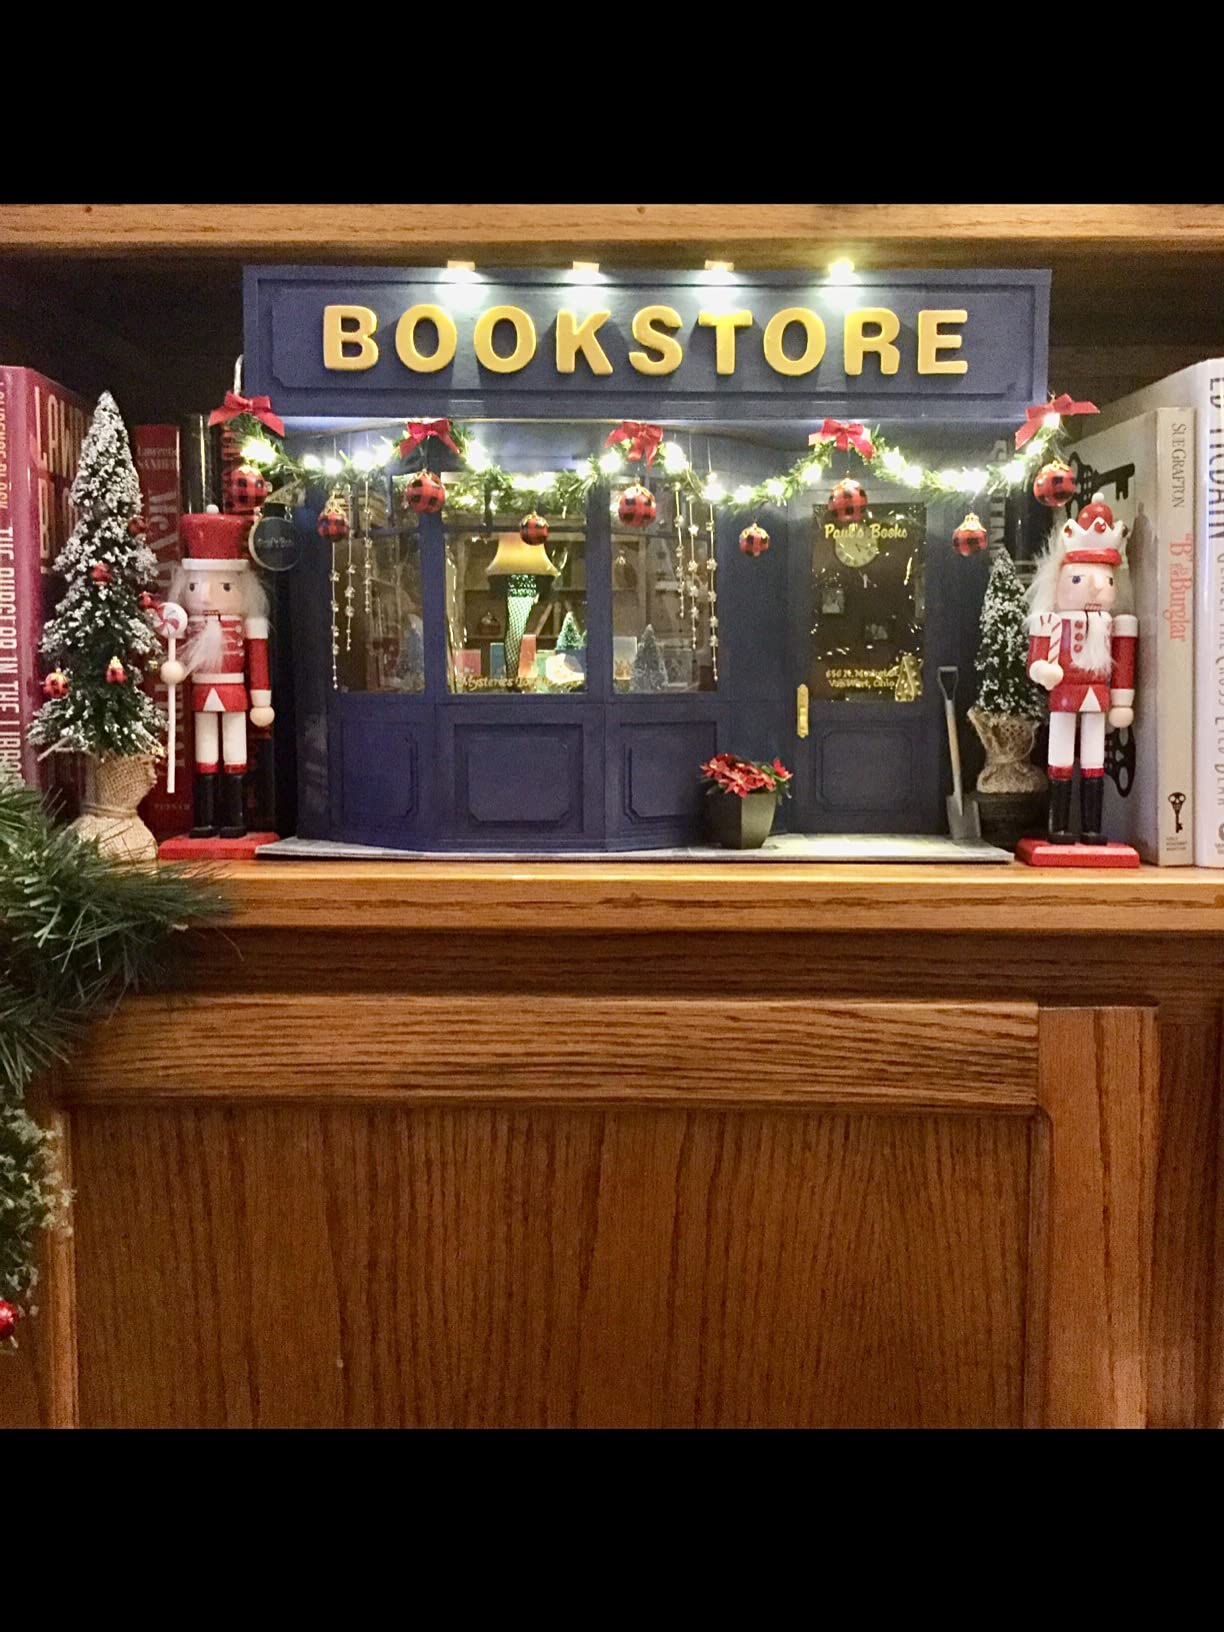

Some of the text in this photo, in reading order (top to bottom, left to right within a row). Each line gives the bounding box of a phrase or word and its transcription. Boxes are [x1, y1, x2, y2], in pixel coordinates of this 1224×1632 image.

[322, 303, 969, 376] BOOKSTORE
[1171, 423, 1187, 509] SUE GRAFTON
[824, 523, 908, 539] Paul's Books
[1163, 577, 1194, 642] Burglar
[0, 680, 20, 713] THE
